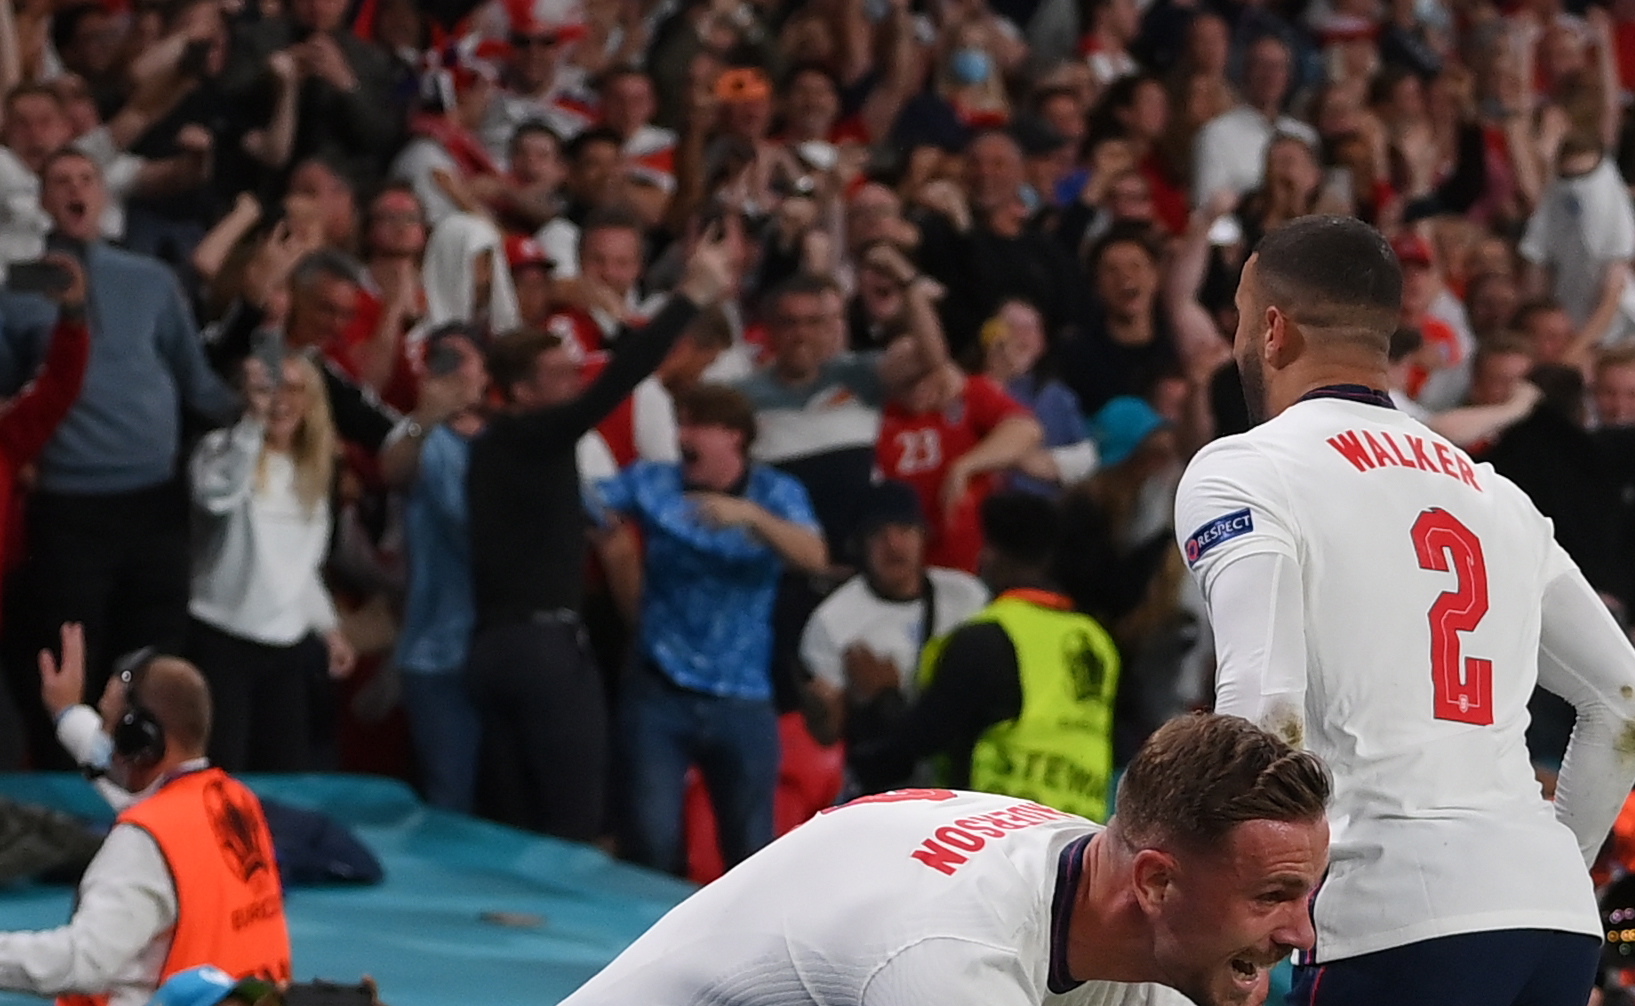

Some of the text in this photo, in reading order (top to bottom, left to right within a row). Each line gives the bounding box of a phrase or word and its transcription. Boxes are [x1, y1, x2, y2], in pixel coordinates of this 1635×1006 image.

[893, 427, 943, 474] 23
[1326, 429, 1483, 493] WALKER
[1196, 514, 1251, 547] RESPECT
[1409, 506, 1495, 726] 2
